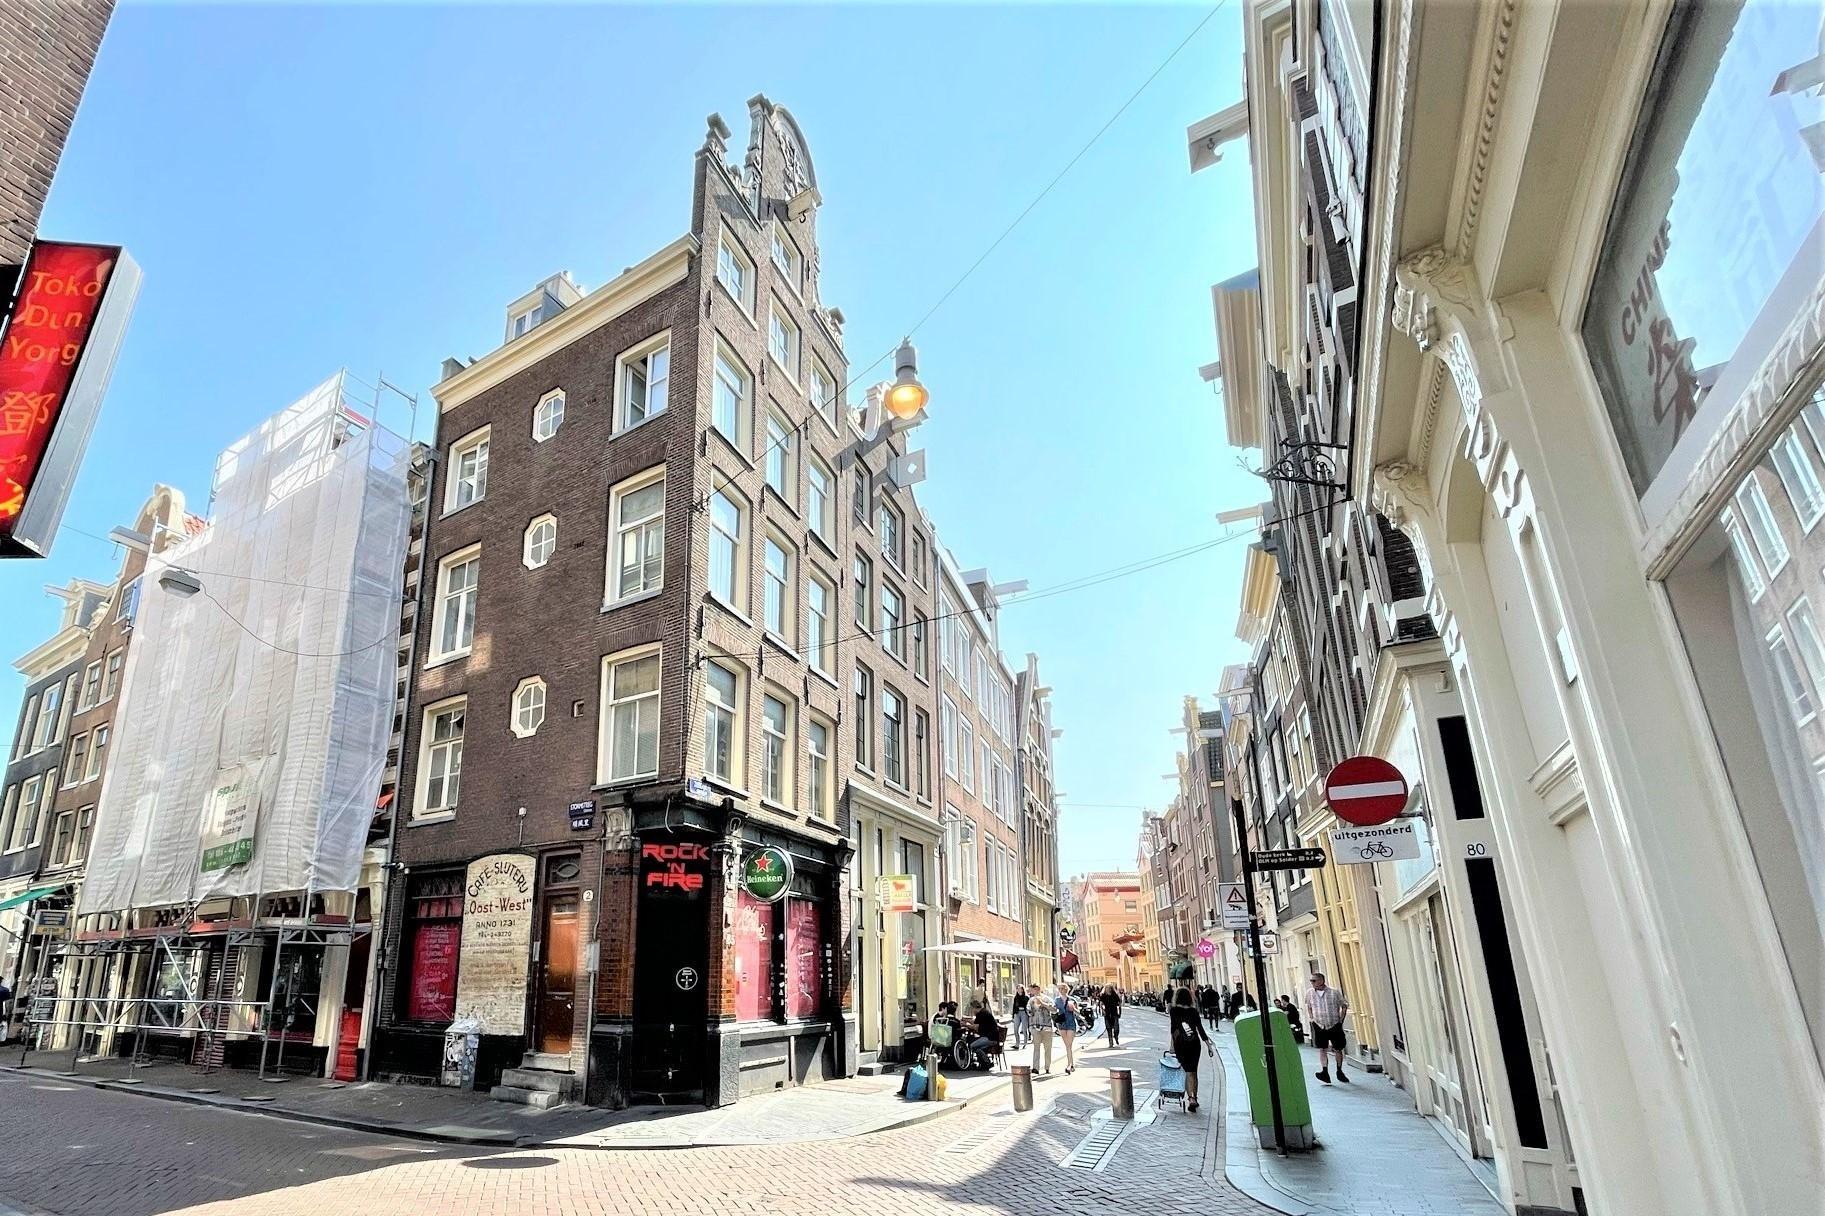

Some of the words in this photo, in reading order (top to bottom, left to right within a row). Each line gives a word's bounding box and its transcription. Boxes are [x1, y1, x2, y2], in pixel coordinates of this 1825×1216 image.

[32, 271, 102, 297] Toko
[1334, 825, 1412, 841] uitgezonderd
[642, 842, 710, 863] ROCK
[1466, 843, 1485, 856] 80
[646, 872, 704, 892] FIRE
[746, 874, 783, 884] Heineken
[475, 920, 497, 929] ANNO
